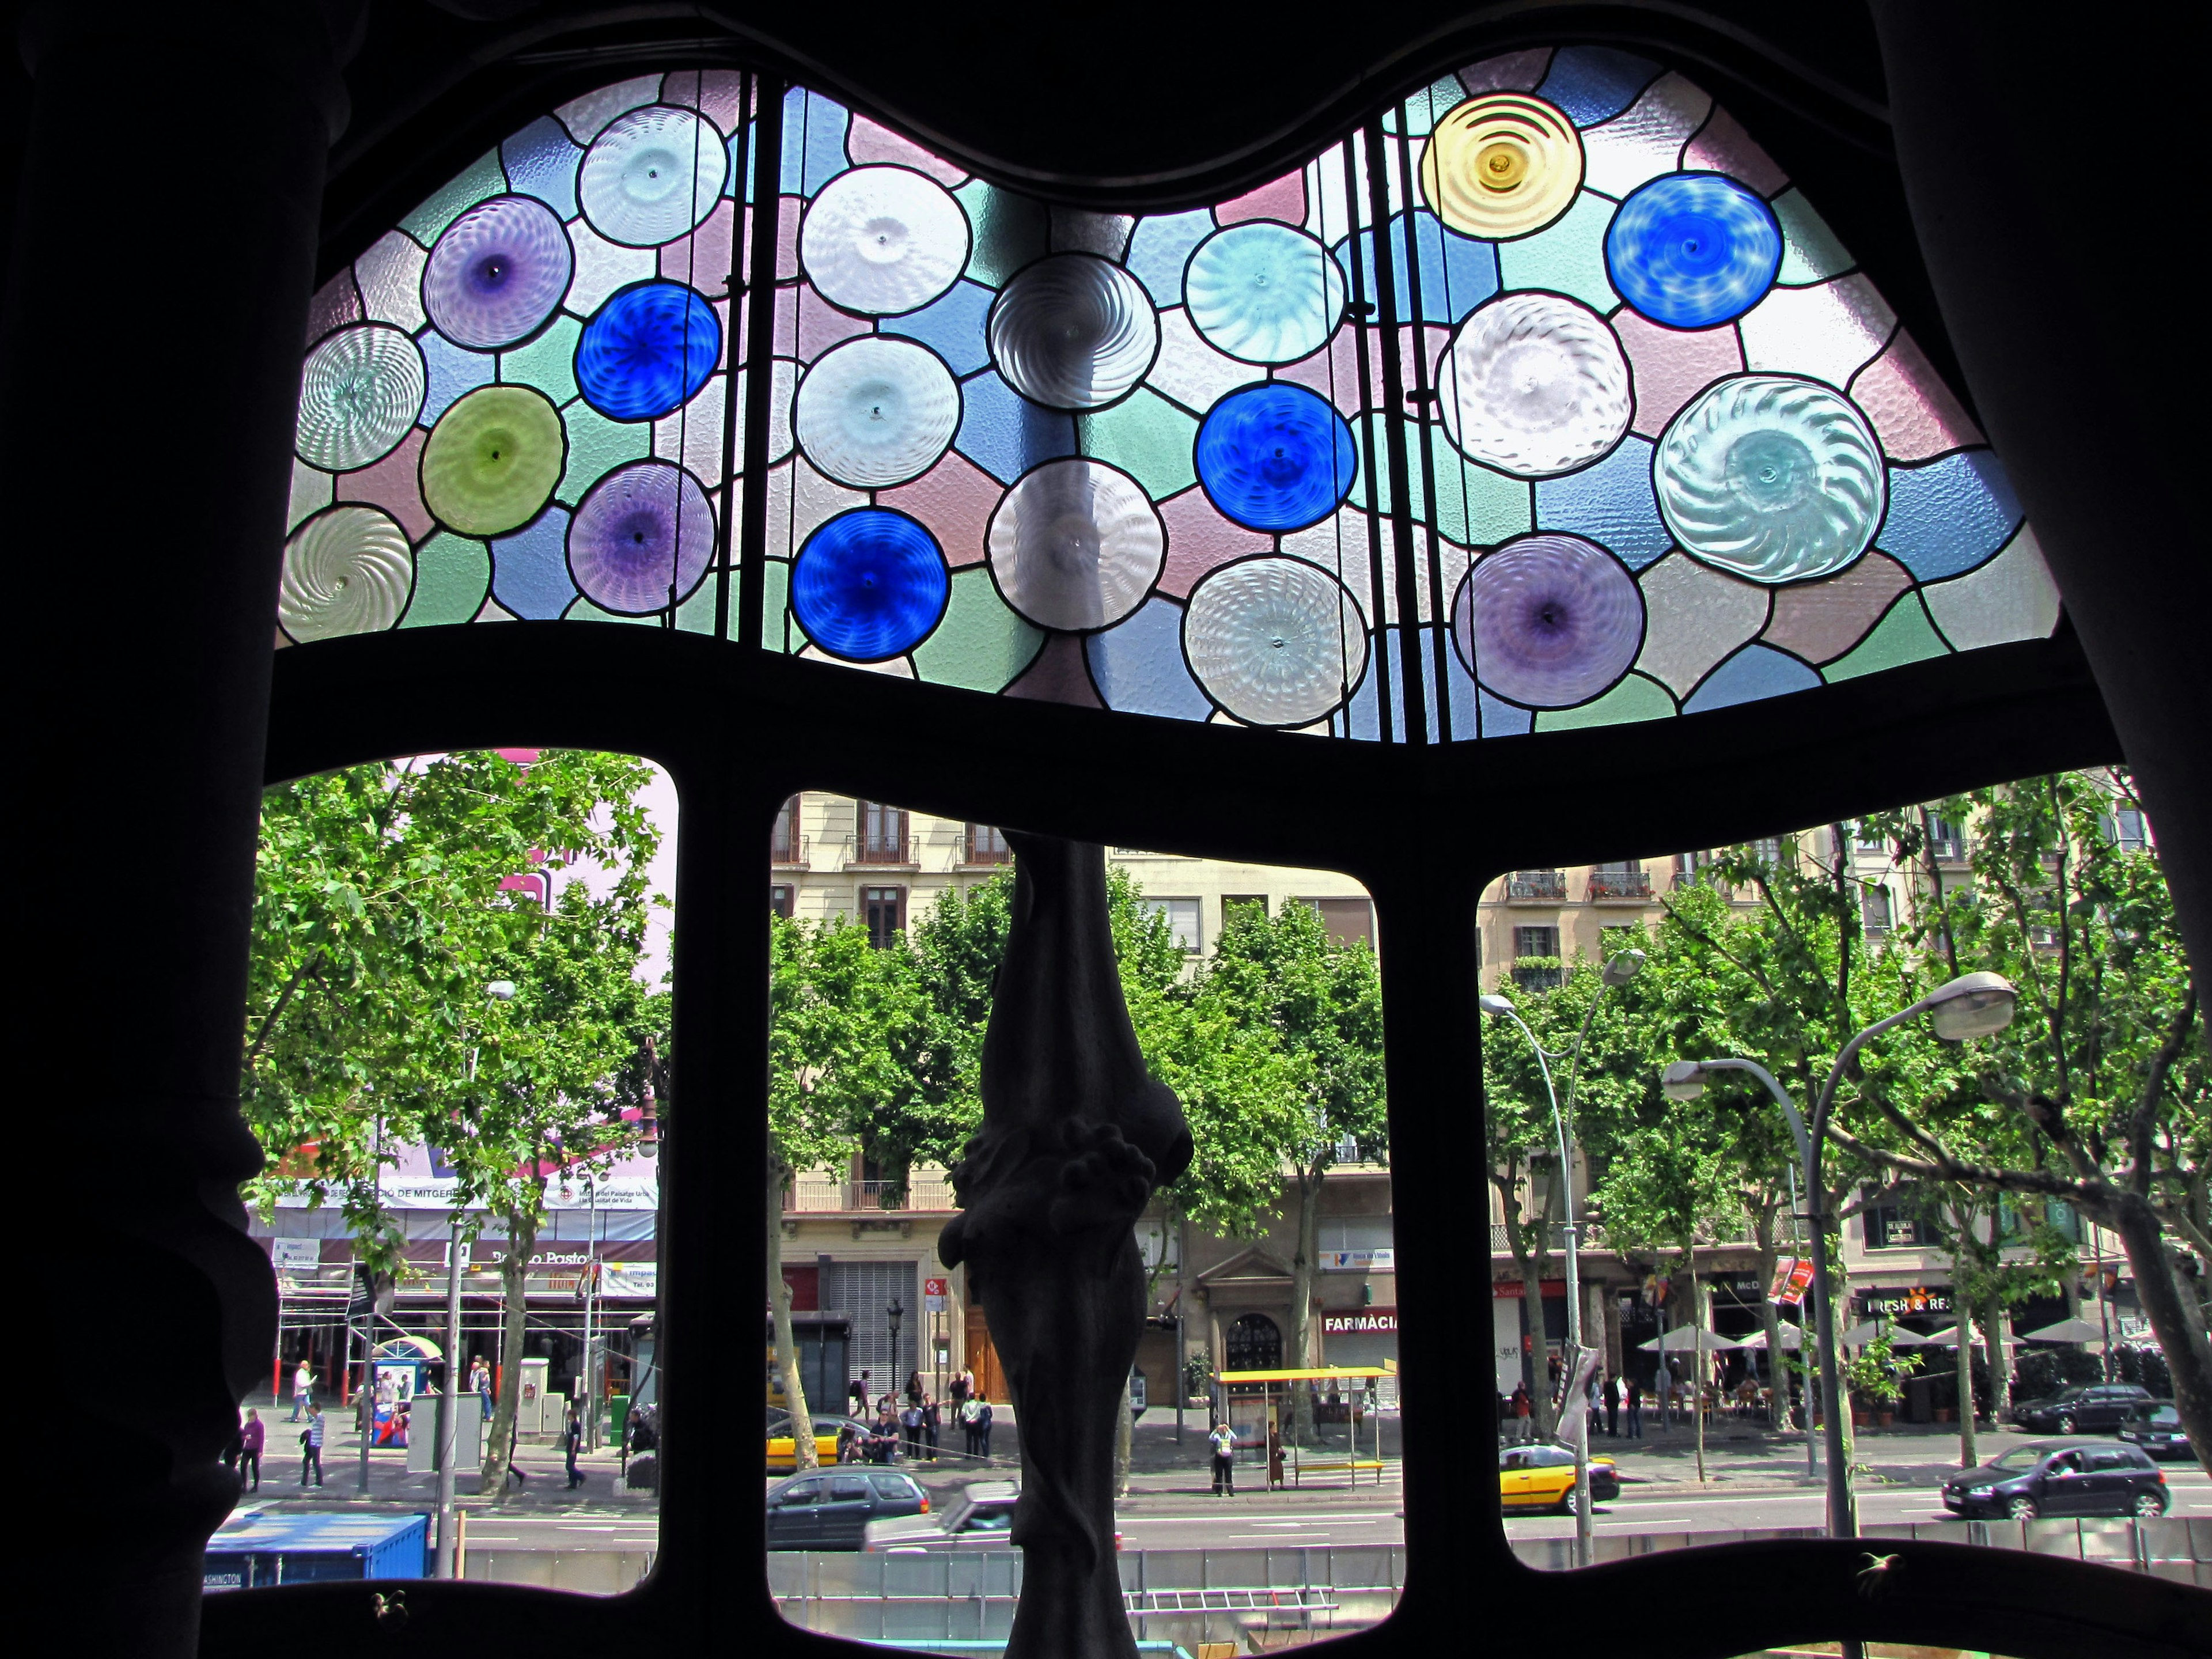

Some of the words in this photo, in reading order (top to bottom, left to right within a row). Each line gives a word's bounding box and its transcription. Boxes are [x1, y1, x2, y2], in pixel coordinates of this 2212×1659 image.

[398, 1189, 411, 1197] DE
[414, 1189, 460, 1198] MITGERE
[1914, 1298, 1925, 1310] &
[203, 1573, 241, 1585] ASHINGTON
